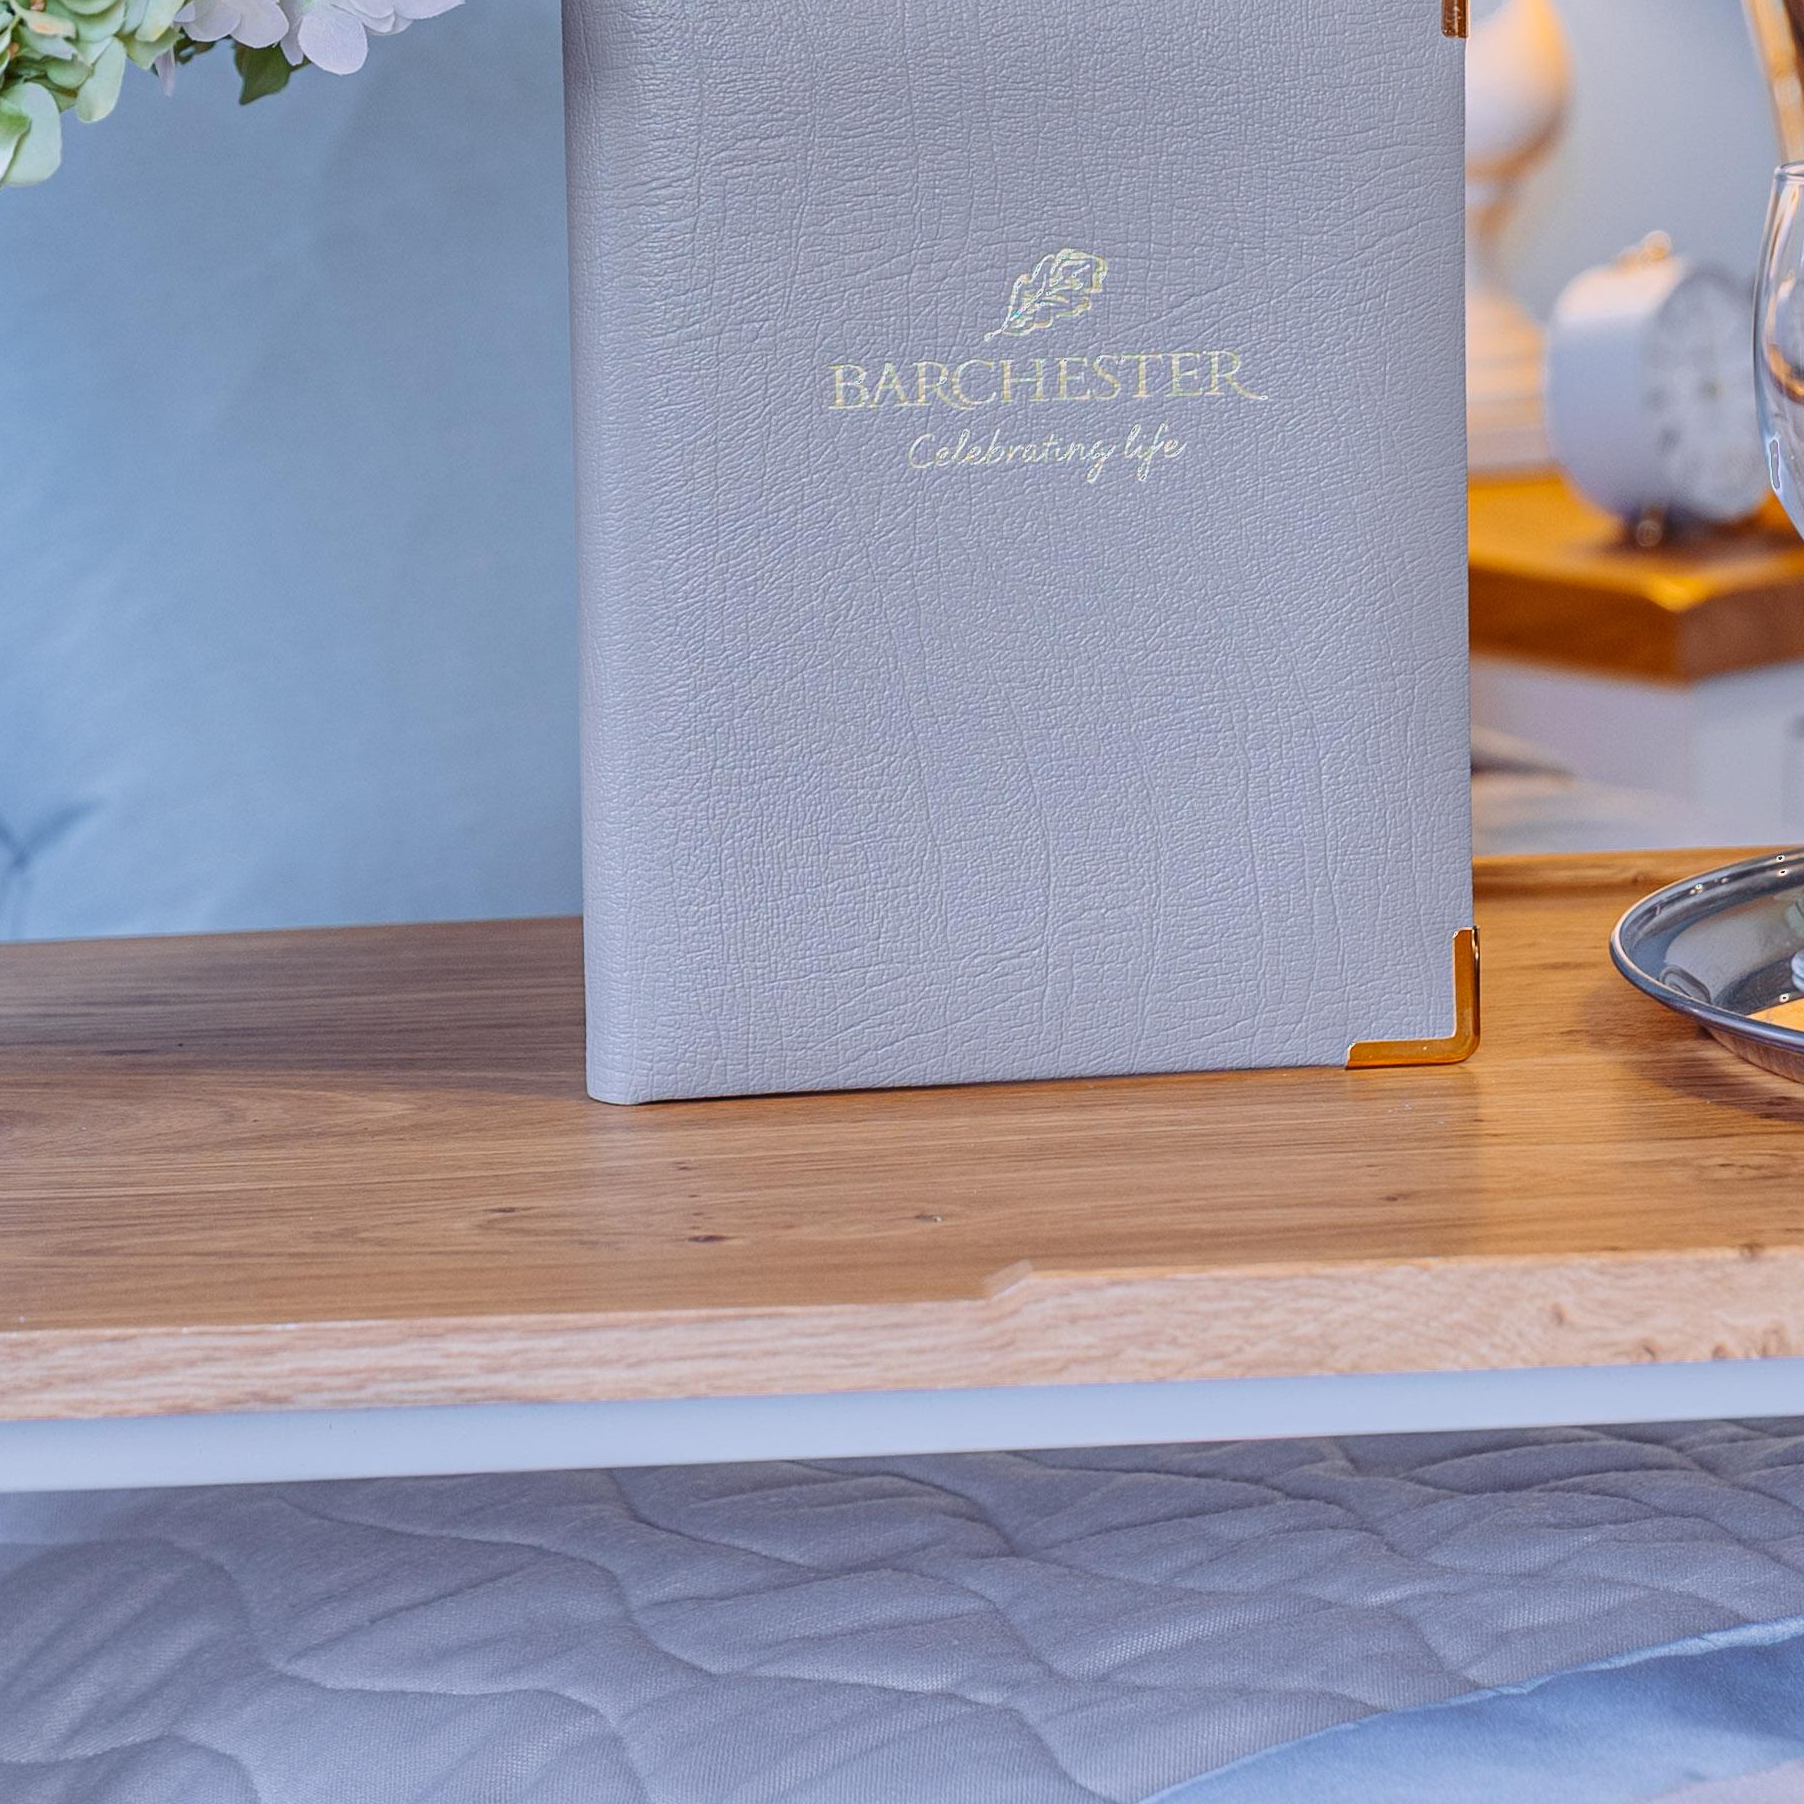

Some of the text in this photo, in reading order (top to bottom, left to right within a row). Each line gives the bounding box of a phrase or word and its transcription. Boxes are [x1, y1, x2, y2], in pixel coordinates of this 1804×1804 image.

[827, 350, 1269, 410] BARCHESTER
[907, 423, 1187, 483] Celebrating life
